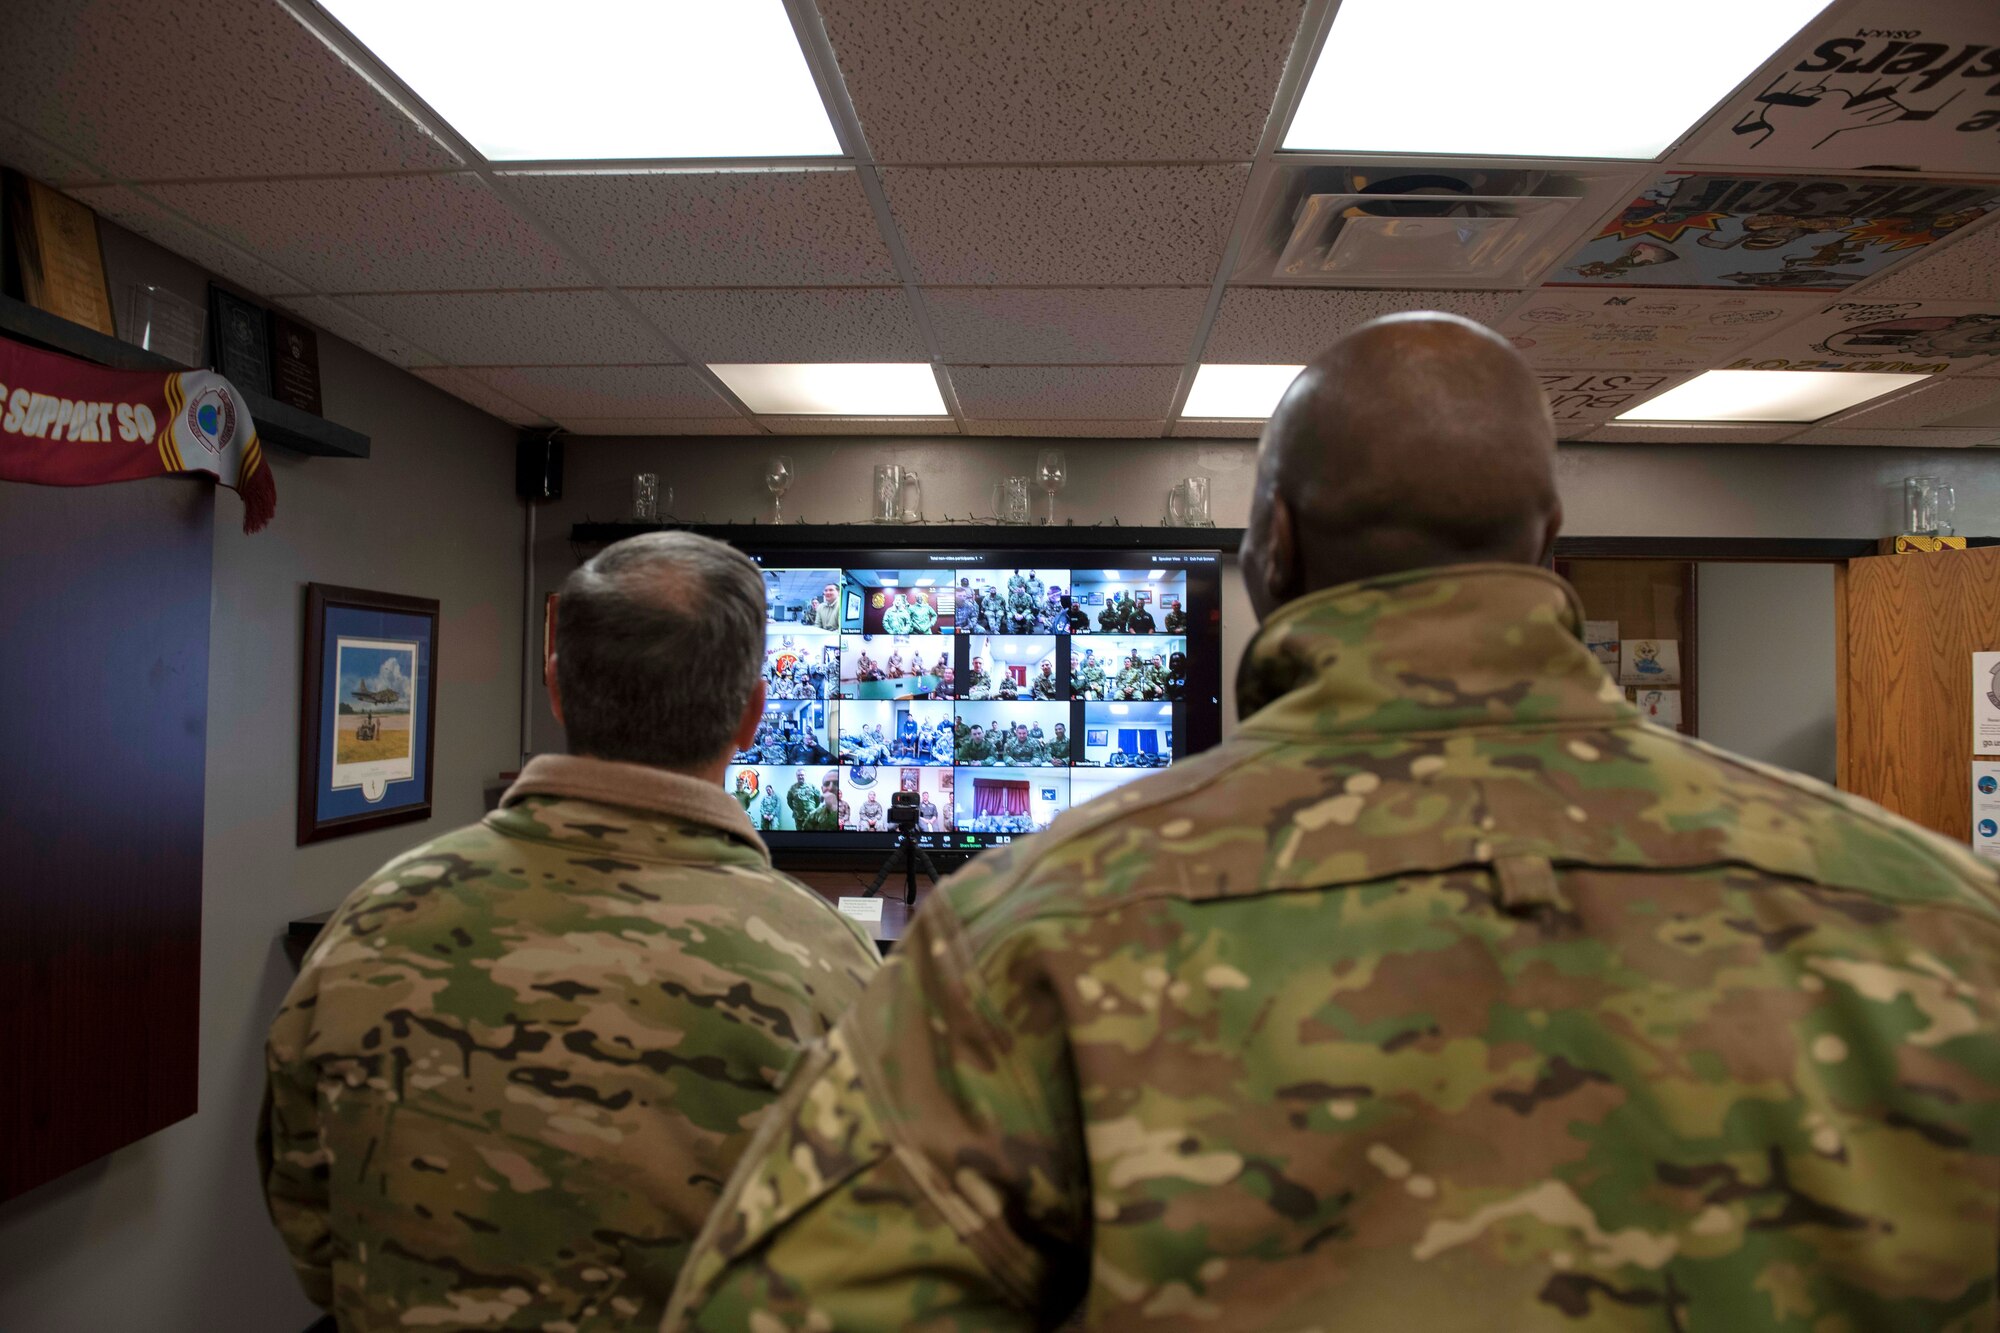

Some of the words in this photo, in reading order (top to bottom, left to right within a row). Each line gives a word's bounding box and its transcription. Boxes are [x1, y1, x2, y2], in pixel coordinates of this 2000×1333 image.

[1795, 38, 2000, 94] sters
[1838, 184, 1990, 215] THE
[3, 387, 114, 442] SUPPORT
[116, 402, 157, 445] SQ
